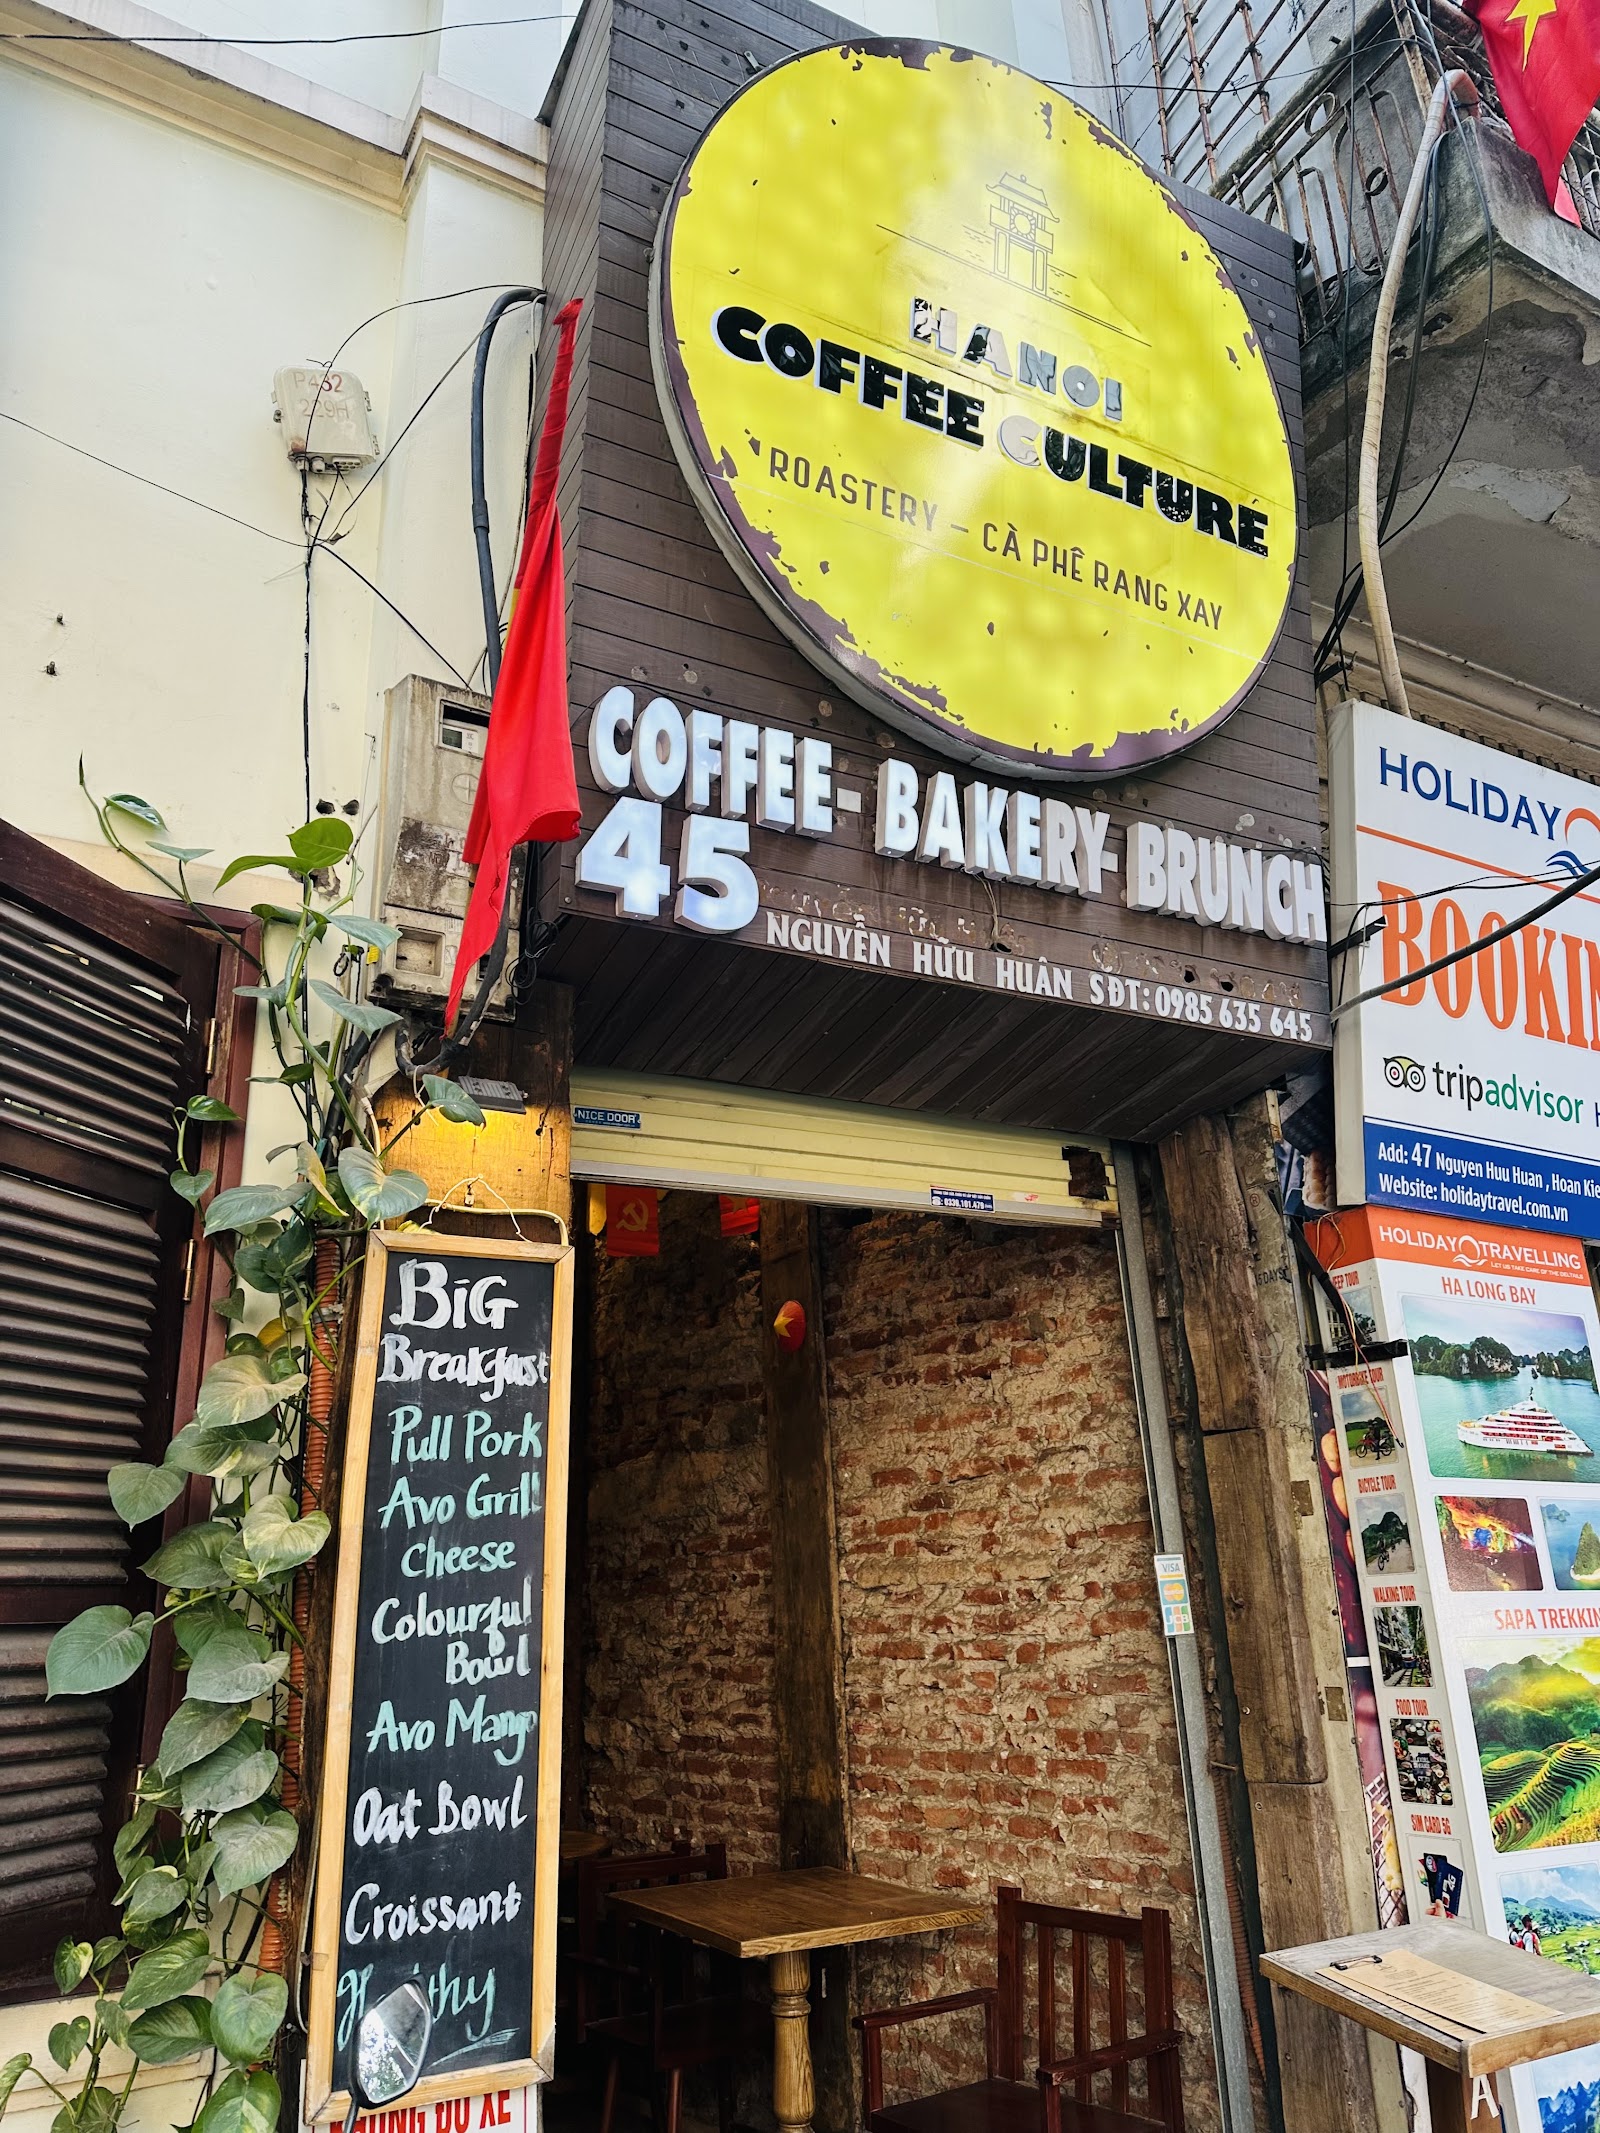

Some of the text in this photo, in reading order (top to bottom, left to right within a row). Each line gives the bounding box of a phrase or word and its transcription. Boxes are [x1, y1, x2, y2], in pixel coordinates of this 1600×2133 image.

[910, 296, 1124, 421] HANOI
[711, 305, 1270, 559] COFFEE CULTURE
[768, 448, 938, 532] ROASTERY
[982, 521, 1023, 564] CÀ
[1032, 539, 1084, 583] PHÊ
[1093, 560, 1169, 613] RANG
[1177, 590, 1224, 631] XAY
[1378, 745, 1563, 842] HOLIDAY
[574, 796, 760, 935] 45
[1127, 820, 1328, 946] BRUNCH
[995, 955, 1073, 1001] HUÂN
[1219, 998, 1262, 1033] 635
[1269, 1007, 1313, 1043] 645
[577, 1110, 605, 1121] NICE
[606, 1112, 636, 1124] DOOR
[1432, 1061, 1584, 1124] tripadvisor
[1378, 1142, 1409, 1165] Add:
[1411, 1142, 1432, 1168] 47
[1436, 1151, 1483, 1178] Nguyen
[1486, 1161, 1510, 1182] Huu
[1551, 1173, 1581, 1196] Hoan
[1378, 1172, 1569, 1223] Website: holidaytravel.com.vn
[1378, 1225, 1582, 1271] HOLIDAY TRAVELLING
[1490, 1261, 1501, 1269] LET
[1511, 1264, 1525, 1272] TAKE
[1525, 1266, 1540, 1274] CARE
[1548, 1269, 1560, 1277] THE
[1441, 1276, 1537, 1306] HA LONG BAY
[388, 1405, 544, 1466] Pull Pork
[378, 1470, 543, 1530] Avo Grill
[1357, 1475, 1397, 1494] BICYCLE TOUR
[1161, 1563, 1181, 1573] VISA
[1373, 1584, 1417, 1603] WALKING TOUR
[371, 1575, 533, 1657] Colourful
[1494, 1608, 1537, 1630] SAPA
[445, 1633, 532, 1686] Bowl
[366, 1700, 435, 1754] Avo
[1395, 1699, 1429, 1716] FOOD TOUR
[352, 1774, 529, 1848] Oat Bowl
[1410, 1814, 1452, 1835] SIM CARD 5G
[344, 1880, 523, 1946] Croissant
